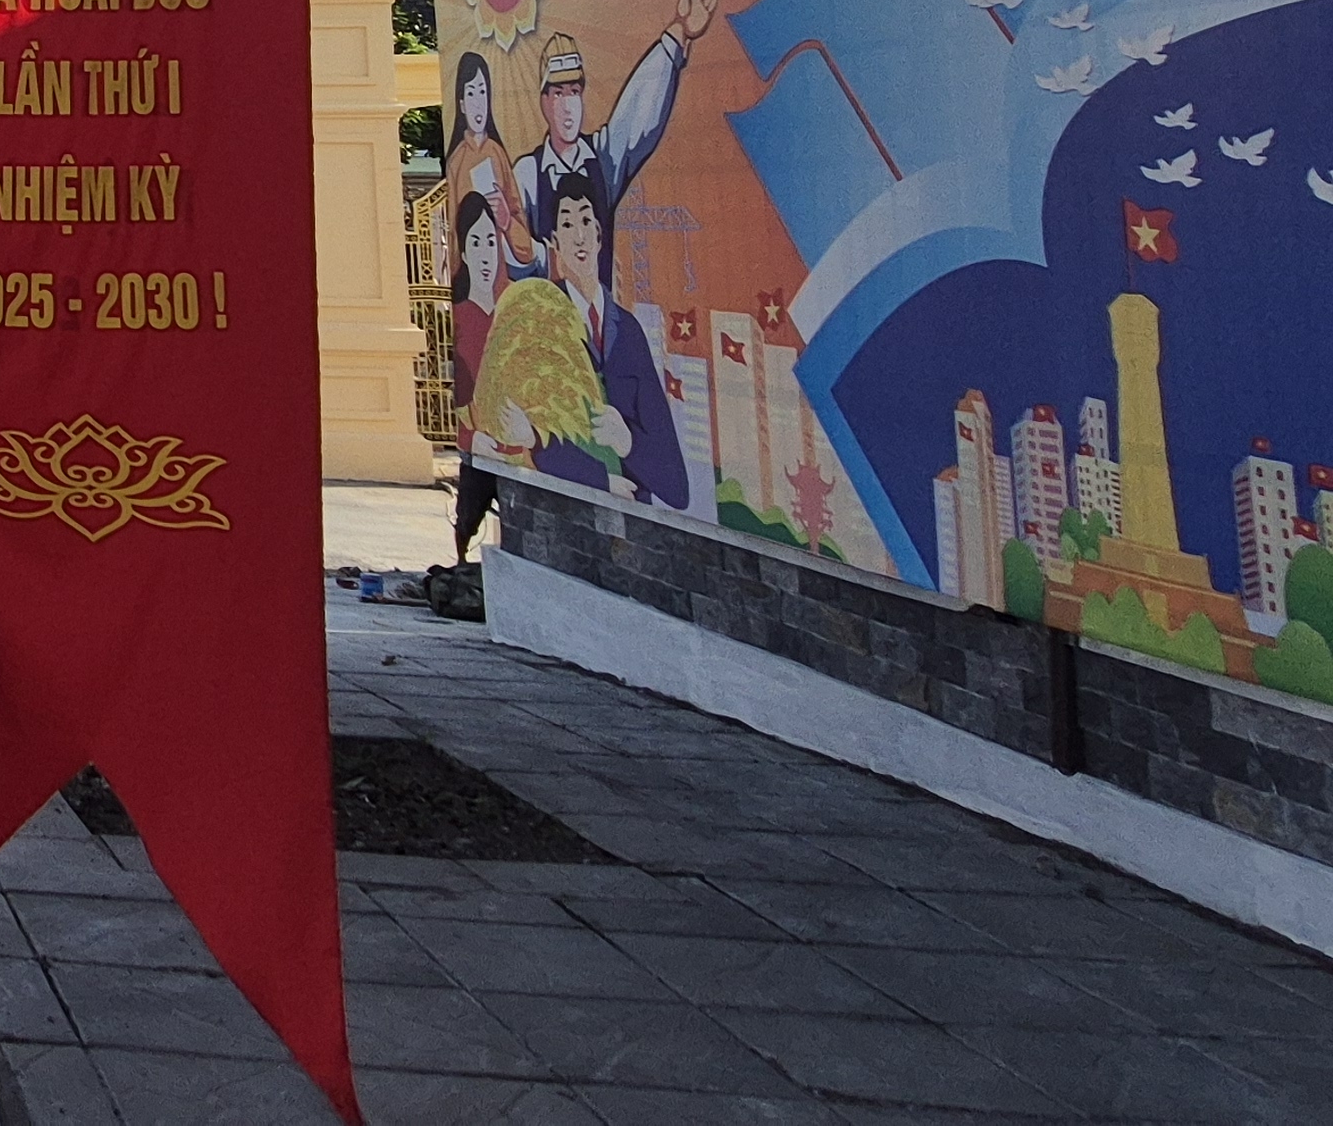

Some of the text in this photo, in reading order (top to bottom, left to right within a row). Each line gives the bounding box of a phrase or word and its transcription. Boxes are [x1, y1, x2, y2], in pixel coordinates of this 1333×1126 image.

[84, 48, 159, 115] THỨ
[168, 60, 181, 114] I
[129, 153, 181, 222] KỲ
[68, 299, 83, 312] -
